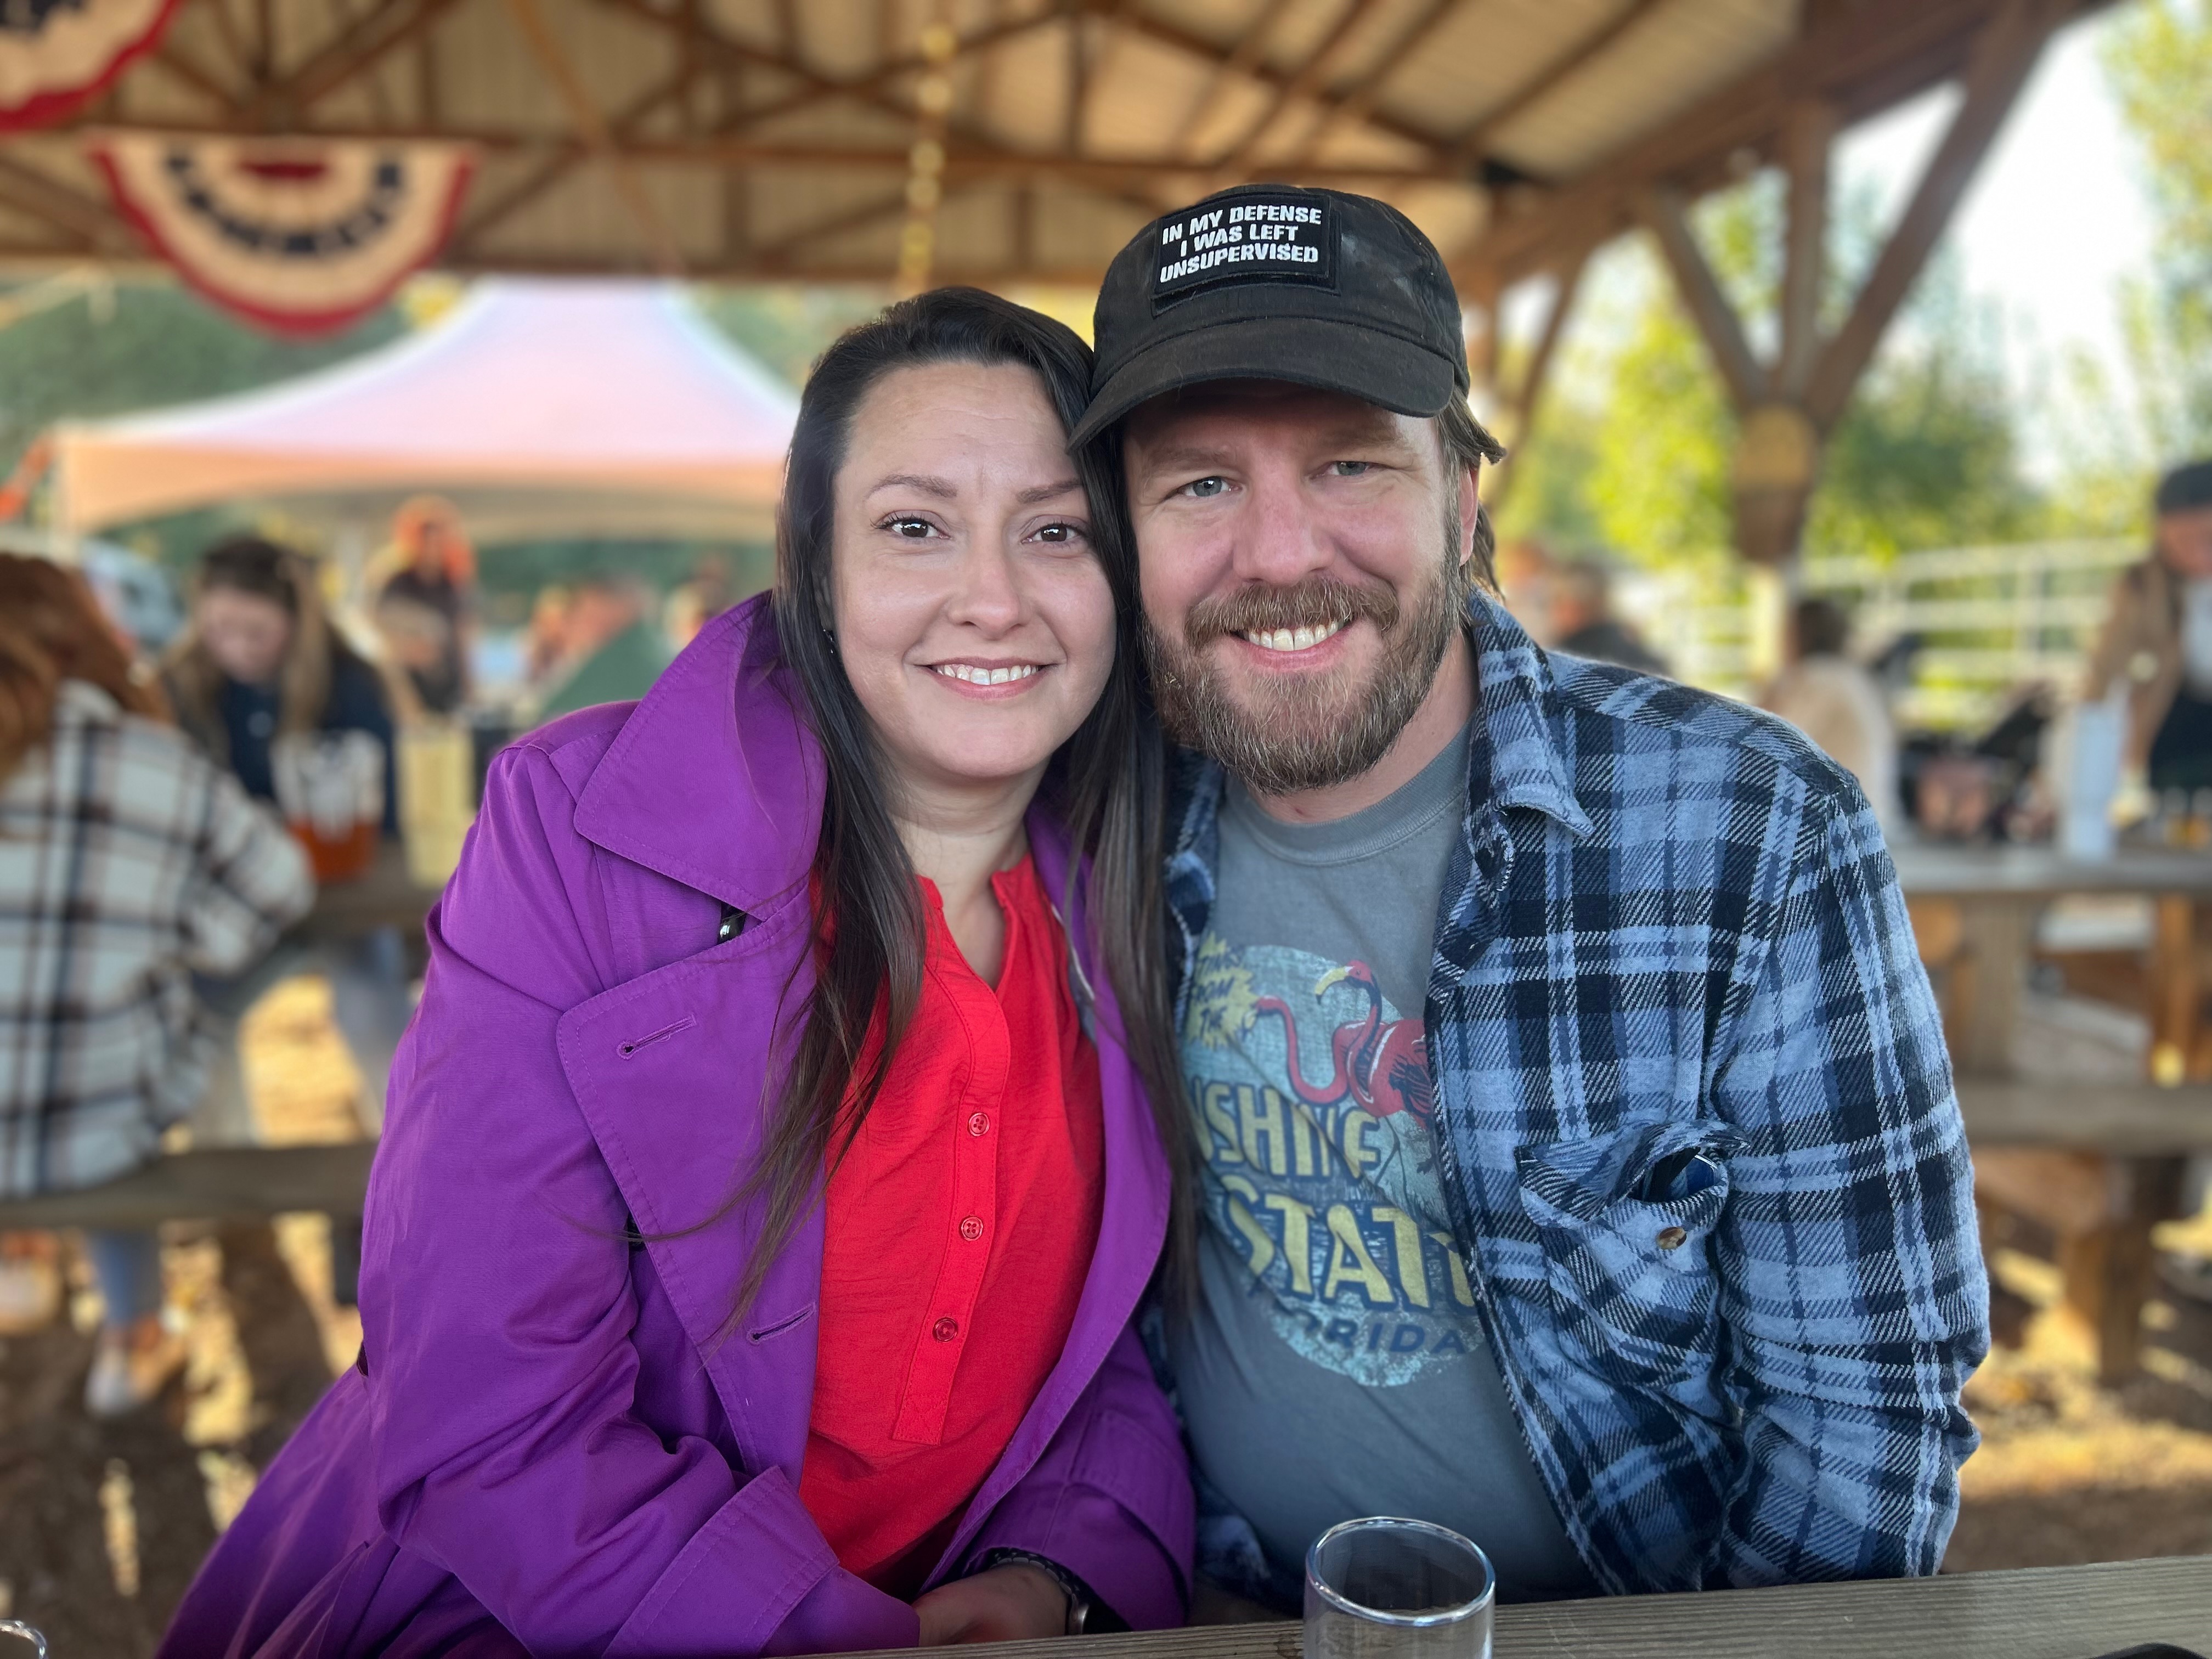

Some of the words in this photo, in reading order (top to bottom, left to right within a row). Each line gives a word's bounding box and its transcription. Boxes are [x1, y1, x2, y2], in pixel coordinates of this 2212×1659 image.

[1163, 223, 1183, 245] IN
[1189, 210, 1223, 236] MY
[1228, 205, 1322, 225] DEFENSE
[1180, 240, 1187, 257] I
[1194, 225, 1243, 252] WAS
[1249, 224, 1299, 242] LEFT
[1160, 242, 1318, 283] UNSUPERVISED
